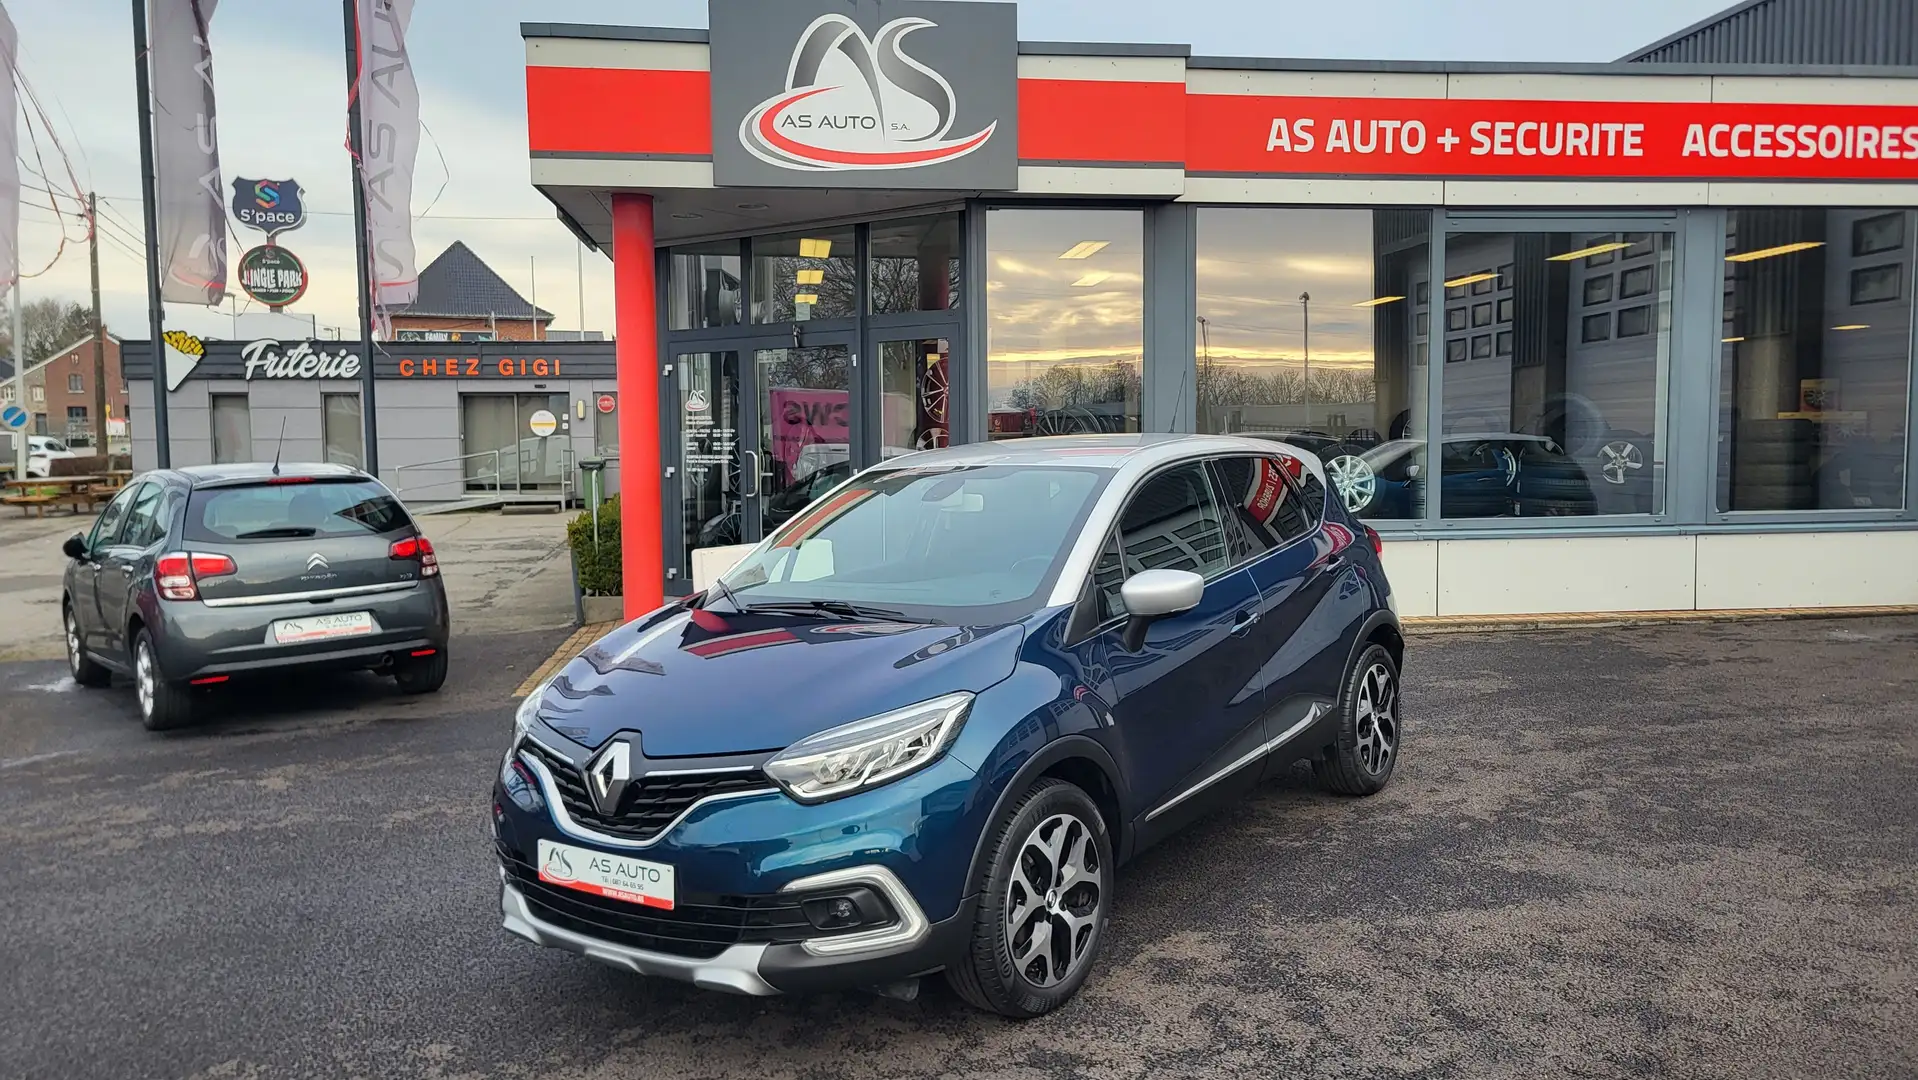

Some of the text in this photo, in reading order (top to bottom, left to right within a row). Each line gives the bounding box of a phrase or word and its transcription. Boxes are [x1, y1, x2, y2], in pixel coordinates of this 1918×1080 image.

[781, 115, 910, 131] AS AUTO S.A.
[1266, 118, 1918, 159] AS AUTO + SECURITE ACCESSOIRES
[367, 120, 397, 213] AS
[240, 209, 295, 224] S'pace
[277, 270, 302, 288] PARK
[241, 337, 362, 380] Friterie
[399, 358, 560, 376] CHEZ GIGI
[334, 614, 362, 624] AUTO
[589, 857, 611, 873] AS
[616, 862, 661, 883] AUTO
